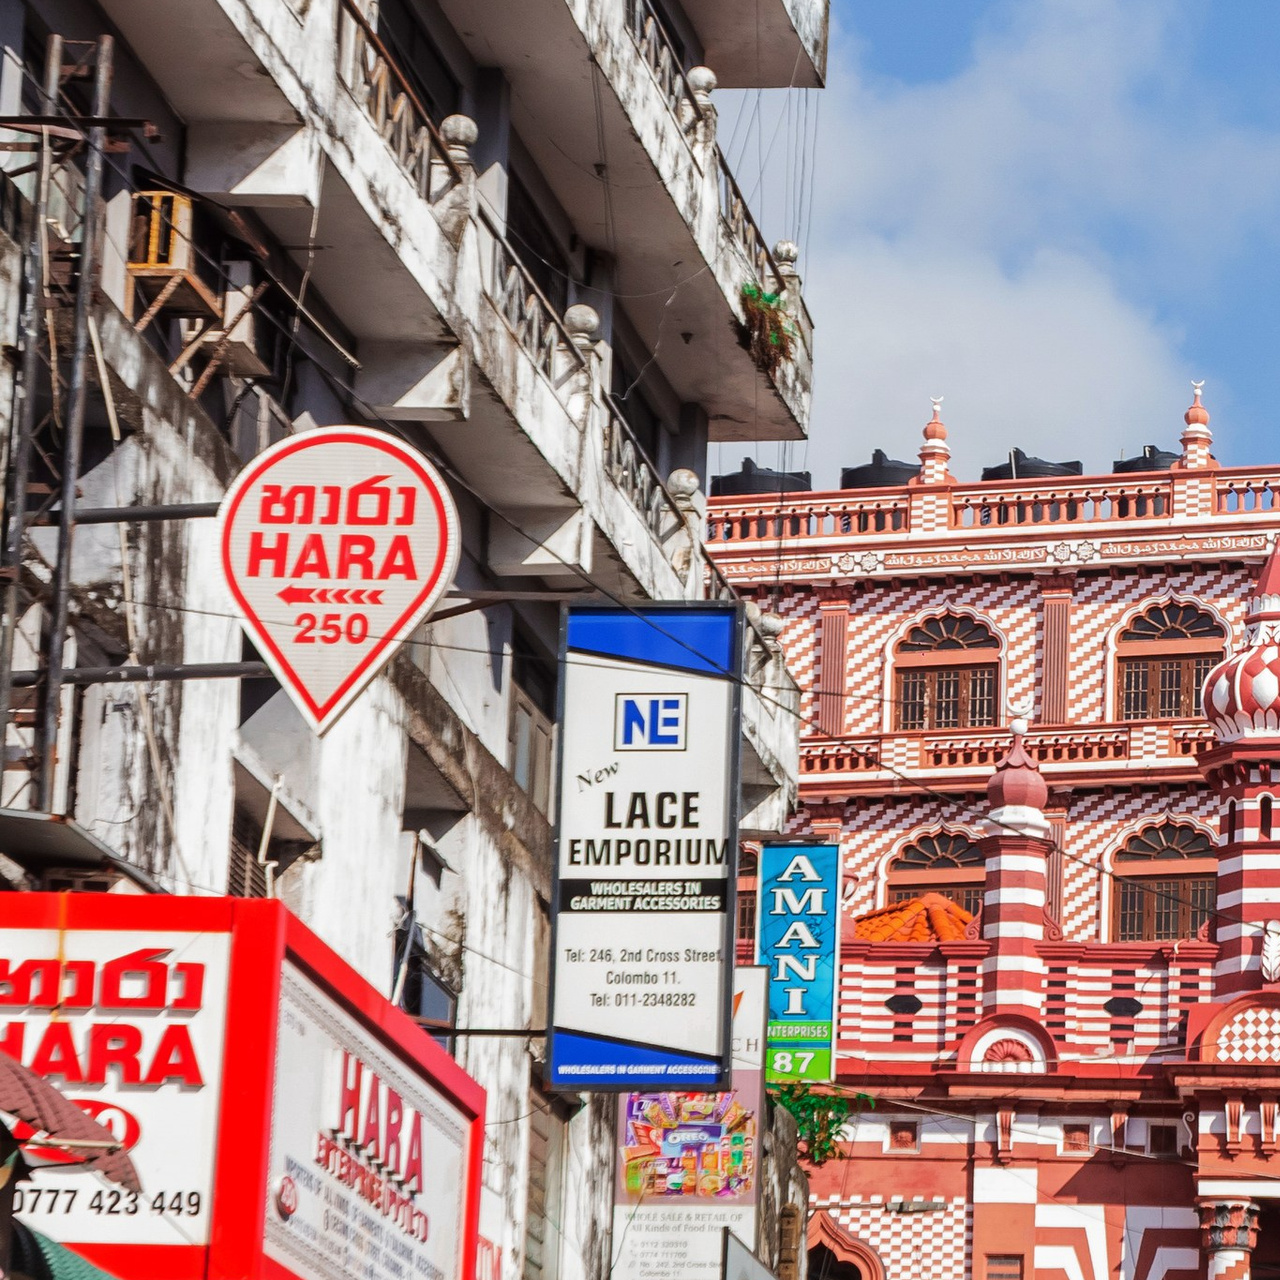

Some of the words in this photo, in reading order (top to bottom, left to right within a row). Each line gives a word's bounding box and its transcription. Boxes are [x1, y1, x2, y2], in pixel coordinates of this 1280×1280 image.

[246, 532, 418, 581] HARA
[293, 613, 369, 644] 250
[575, 761, 620, 793] New
[604, 791, 700, 829] LACE
[568, 838, 730, 866] EMPORIUM
[590, 881, 682, 896] WHOLESALERS
[684, 881, 702, 895] IN
[570, 896, 631, 910] GARMENT
[633, 896, 721, 910] ACCESSORIES
[769, 855, 829, 1014] AMANI
[565, 948, 585, 963] Tel:
[589, 949, 615, 964] 246,
[620, 949, 642, 963] 2nd
[646, 949, 680, 963] Cross
[606, 970, 658, 985] Colombo
[662, 971, 681, 985] 11.
[590, 993, 610, 1007] Tel:
[767, 1024, 829, 1038] NTERPRISES
[772, 1051, 815, 1074] 87
[339, 1050, 423, 1196] HARA
[668, 1132, 709, 1144] OREO
[89, 1189, 139, 1215] 423
[151, 1190, 201, 1216] 449
[660, 1212, 682, 1222] SALE
